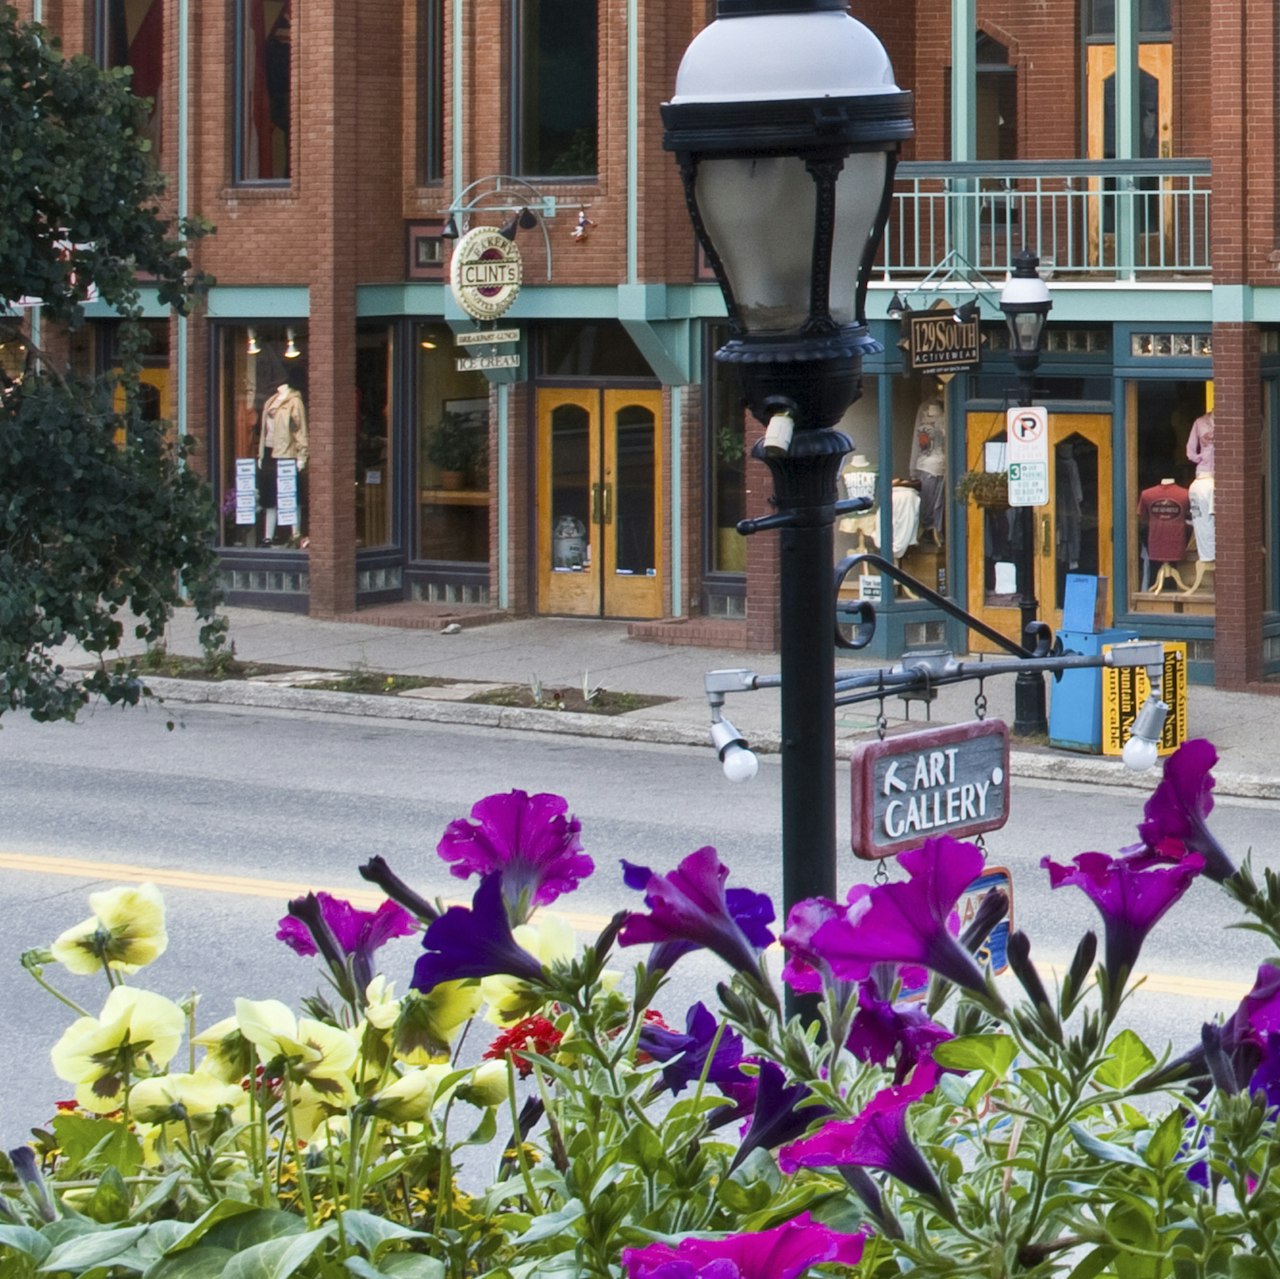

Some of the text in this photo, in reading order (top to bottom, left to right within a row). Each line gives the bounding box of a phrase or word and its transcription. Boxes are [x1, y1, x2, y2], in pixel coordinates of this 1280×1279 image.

[474, 236, 515, 258] BAKERY
[465, 265, 516, 283] CLINT's
[459, 354, 519, 370] ICE CREAM
[915, 349, 977, 362] ACTIVEWEAR
[1121, 667, 1132, 713] ountain
[1110, 707, 1119, 749] cable
[1164, 714, 1175, 748] News
[913, 749, 959, 792] ART
[884, 780, 990, 839] GALLERY
